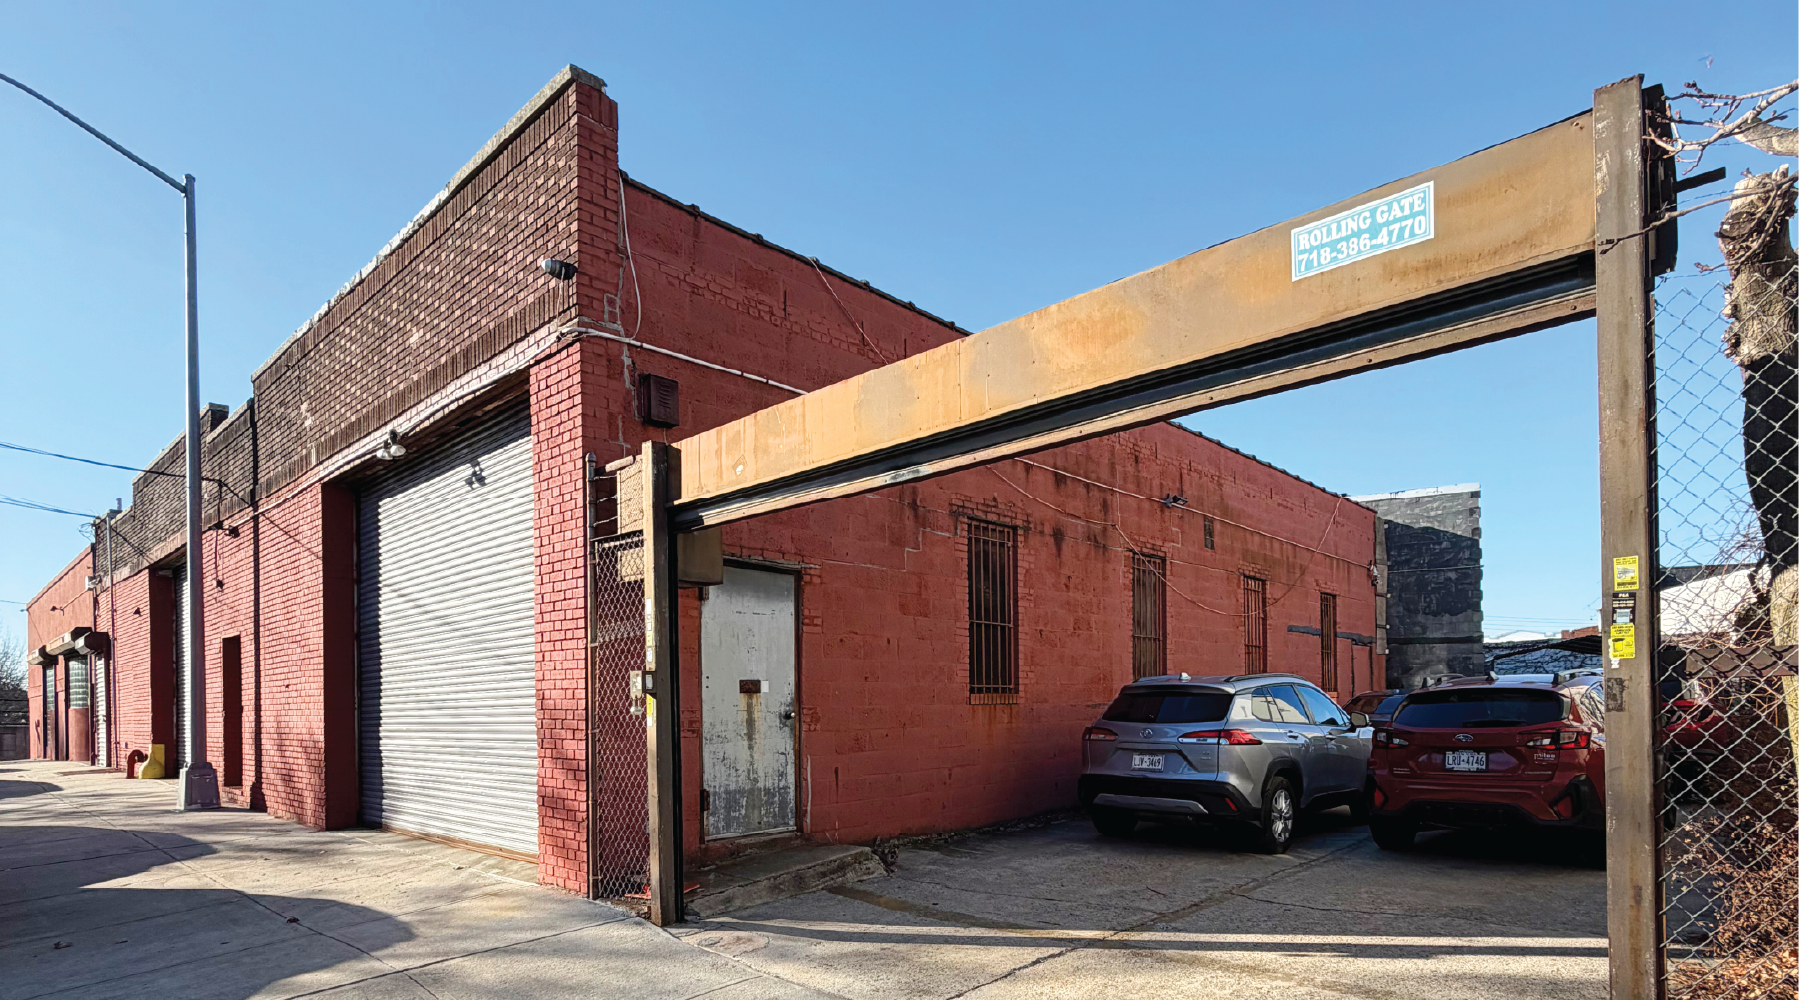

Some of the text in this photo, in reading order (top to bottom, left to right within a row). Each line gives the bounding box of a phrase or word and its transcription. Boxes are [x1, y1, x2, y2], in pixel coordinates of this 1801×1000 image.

[1298, 192, 1426, 250] ROLLING GATE
[1298, 215, 1426, 272] 718-386-4770
